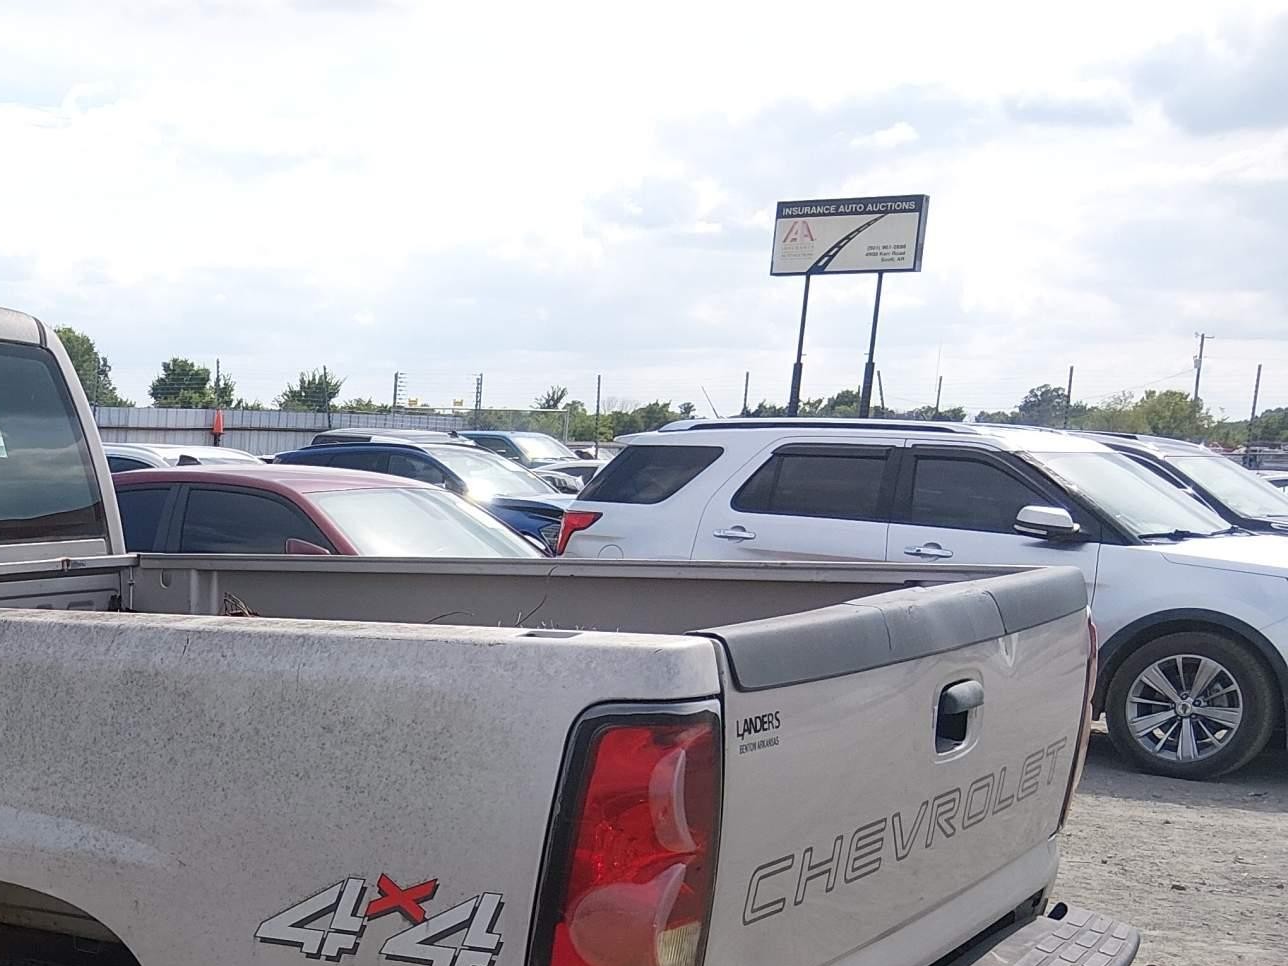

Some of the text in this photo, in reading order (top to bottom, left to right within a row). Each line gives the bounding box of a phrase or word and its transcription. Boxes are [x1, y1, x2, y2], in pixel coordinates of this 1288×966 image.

[782, 201, 916, 215] INSURANCE AUTO AUCTIONS
[736, 710, 781, 741] LANDERS
[742, 737, 1068, 926] CHEVROLET
